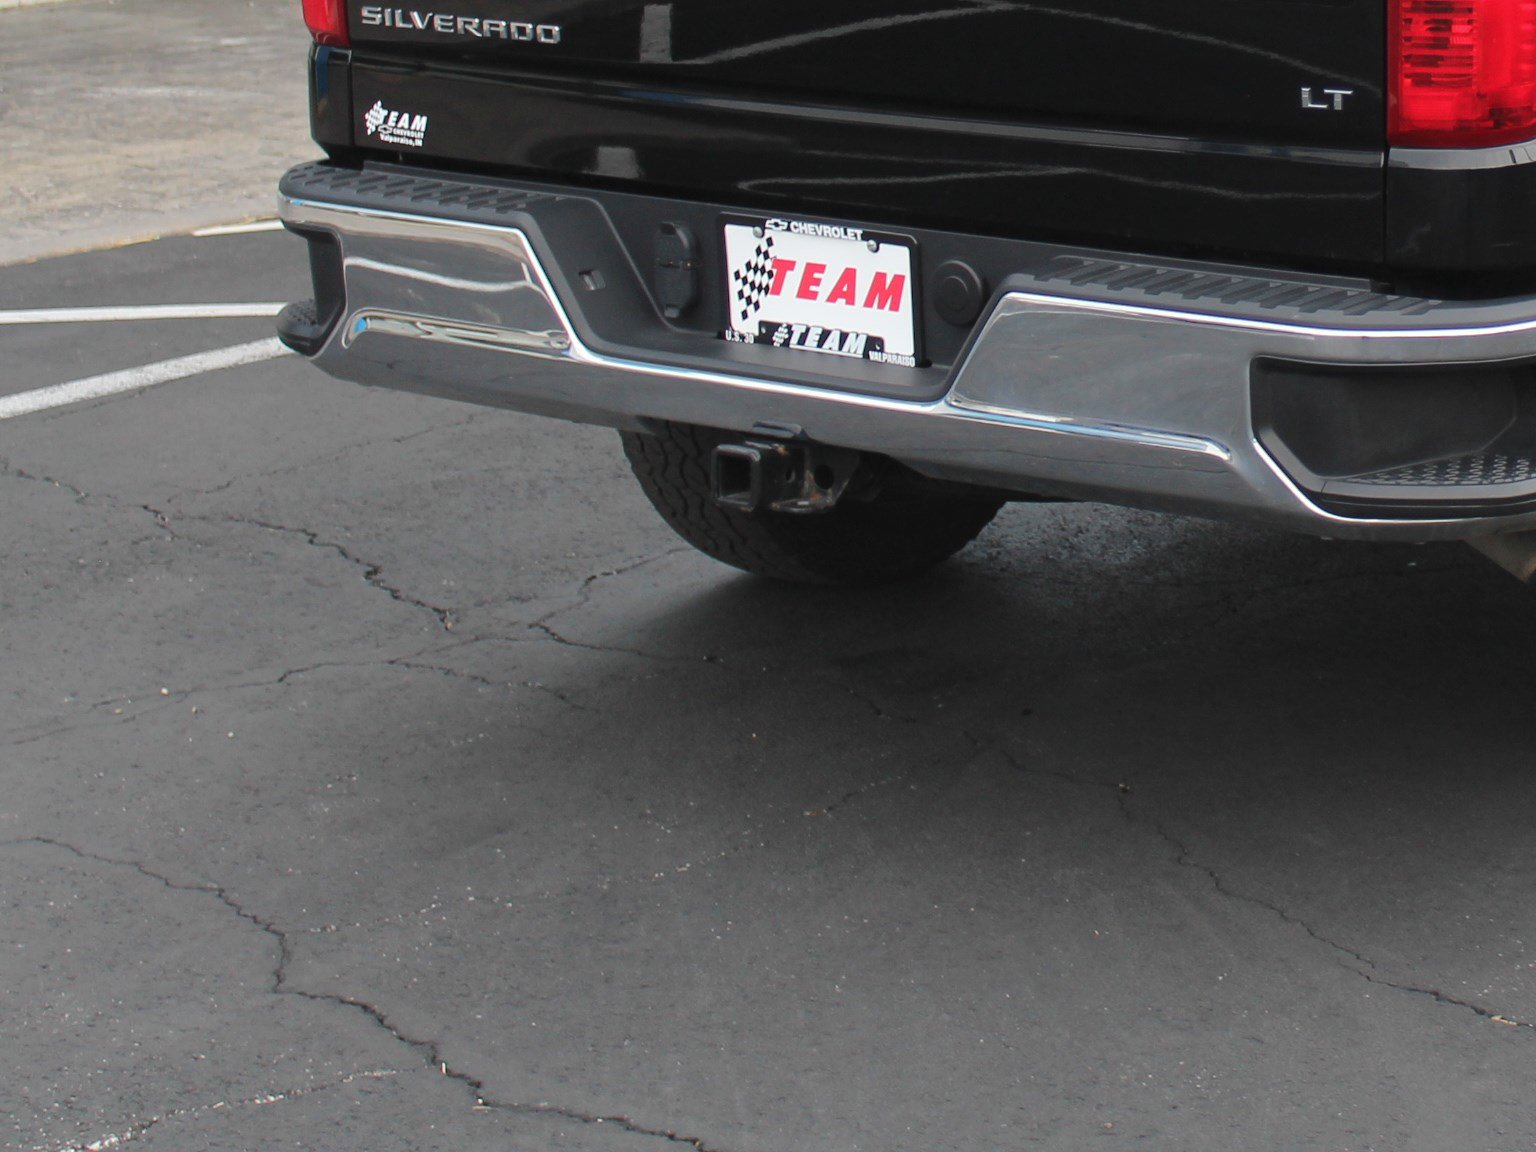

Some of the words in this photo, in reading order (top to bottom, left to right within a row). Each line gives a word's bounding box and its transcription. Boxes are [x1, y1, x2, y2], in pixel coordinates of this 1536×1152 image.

[361, 6, 562, 44] SILVERADO
[1301, 87, 1353, 111] LT
[379, 108, 428, 132] TEAM
[790, 221, 863, 241] CHEVROLET
[769, 257, 906, 312] TEAM
[725, 329, 742, 343] U.S.
[744, 332, 754, 344] 30
[788, 323, 868, 356] TEAM
[868, 350, 916, 367] VALPARAISO
